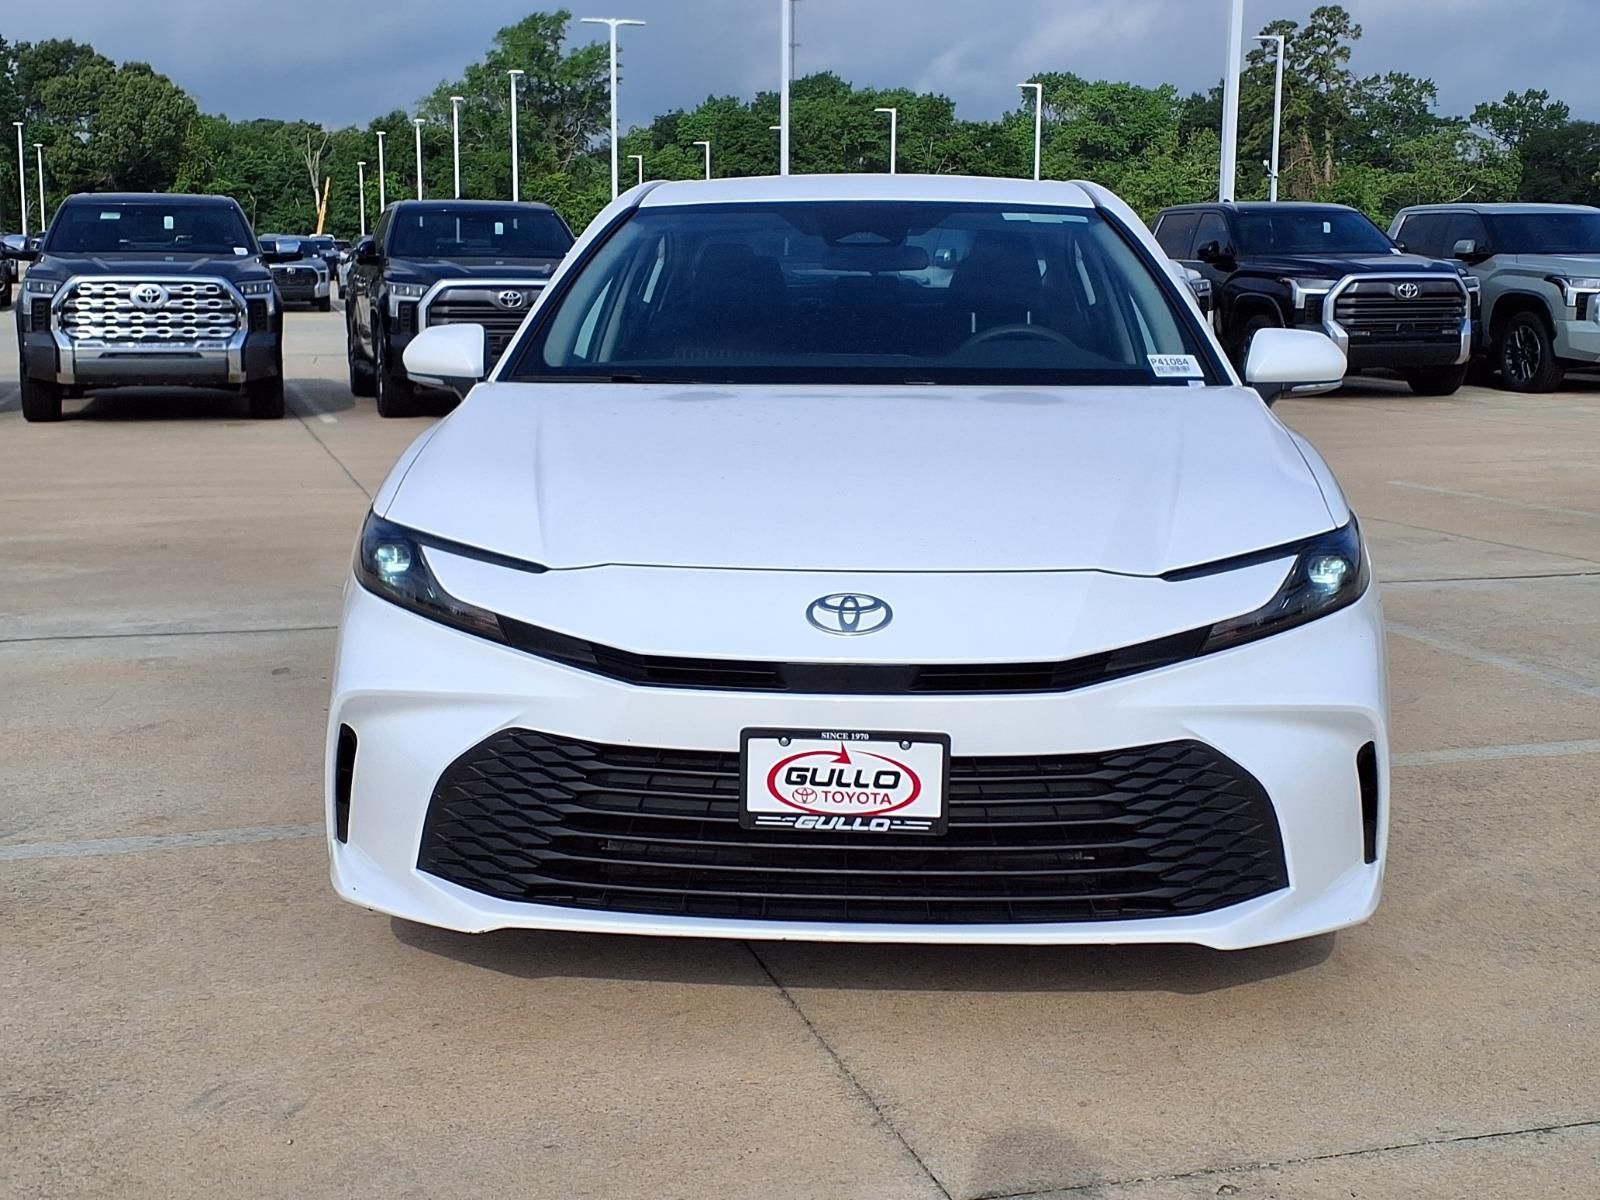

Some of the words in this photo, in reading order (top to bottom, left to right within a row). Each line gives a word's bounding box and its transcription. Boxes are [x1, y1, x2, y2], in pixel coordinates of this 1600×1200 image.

[1150, 358, 1189, 366] P41084
[821, 731, 849, 740] SINCE
[850, 732, 870, 741] 1970
[784, 766, 902, 790] GULLO
[821, 790, 892, 805] TOYOTA
[794, 815, 891, 832] GULLO
